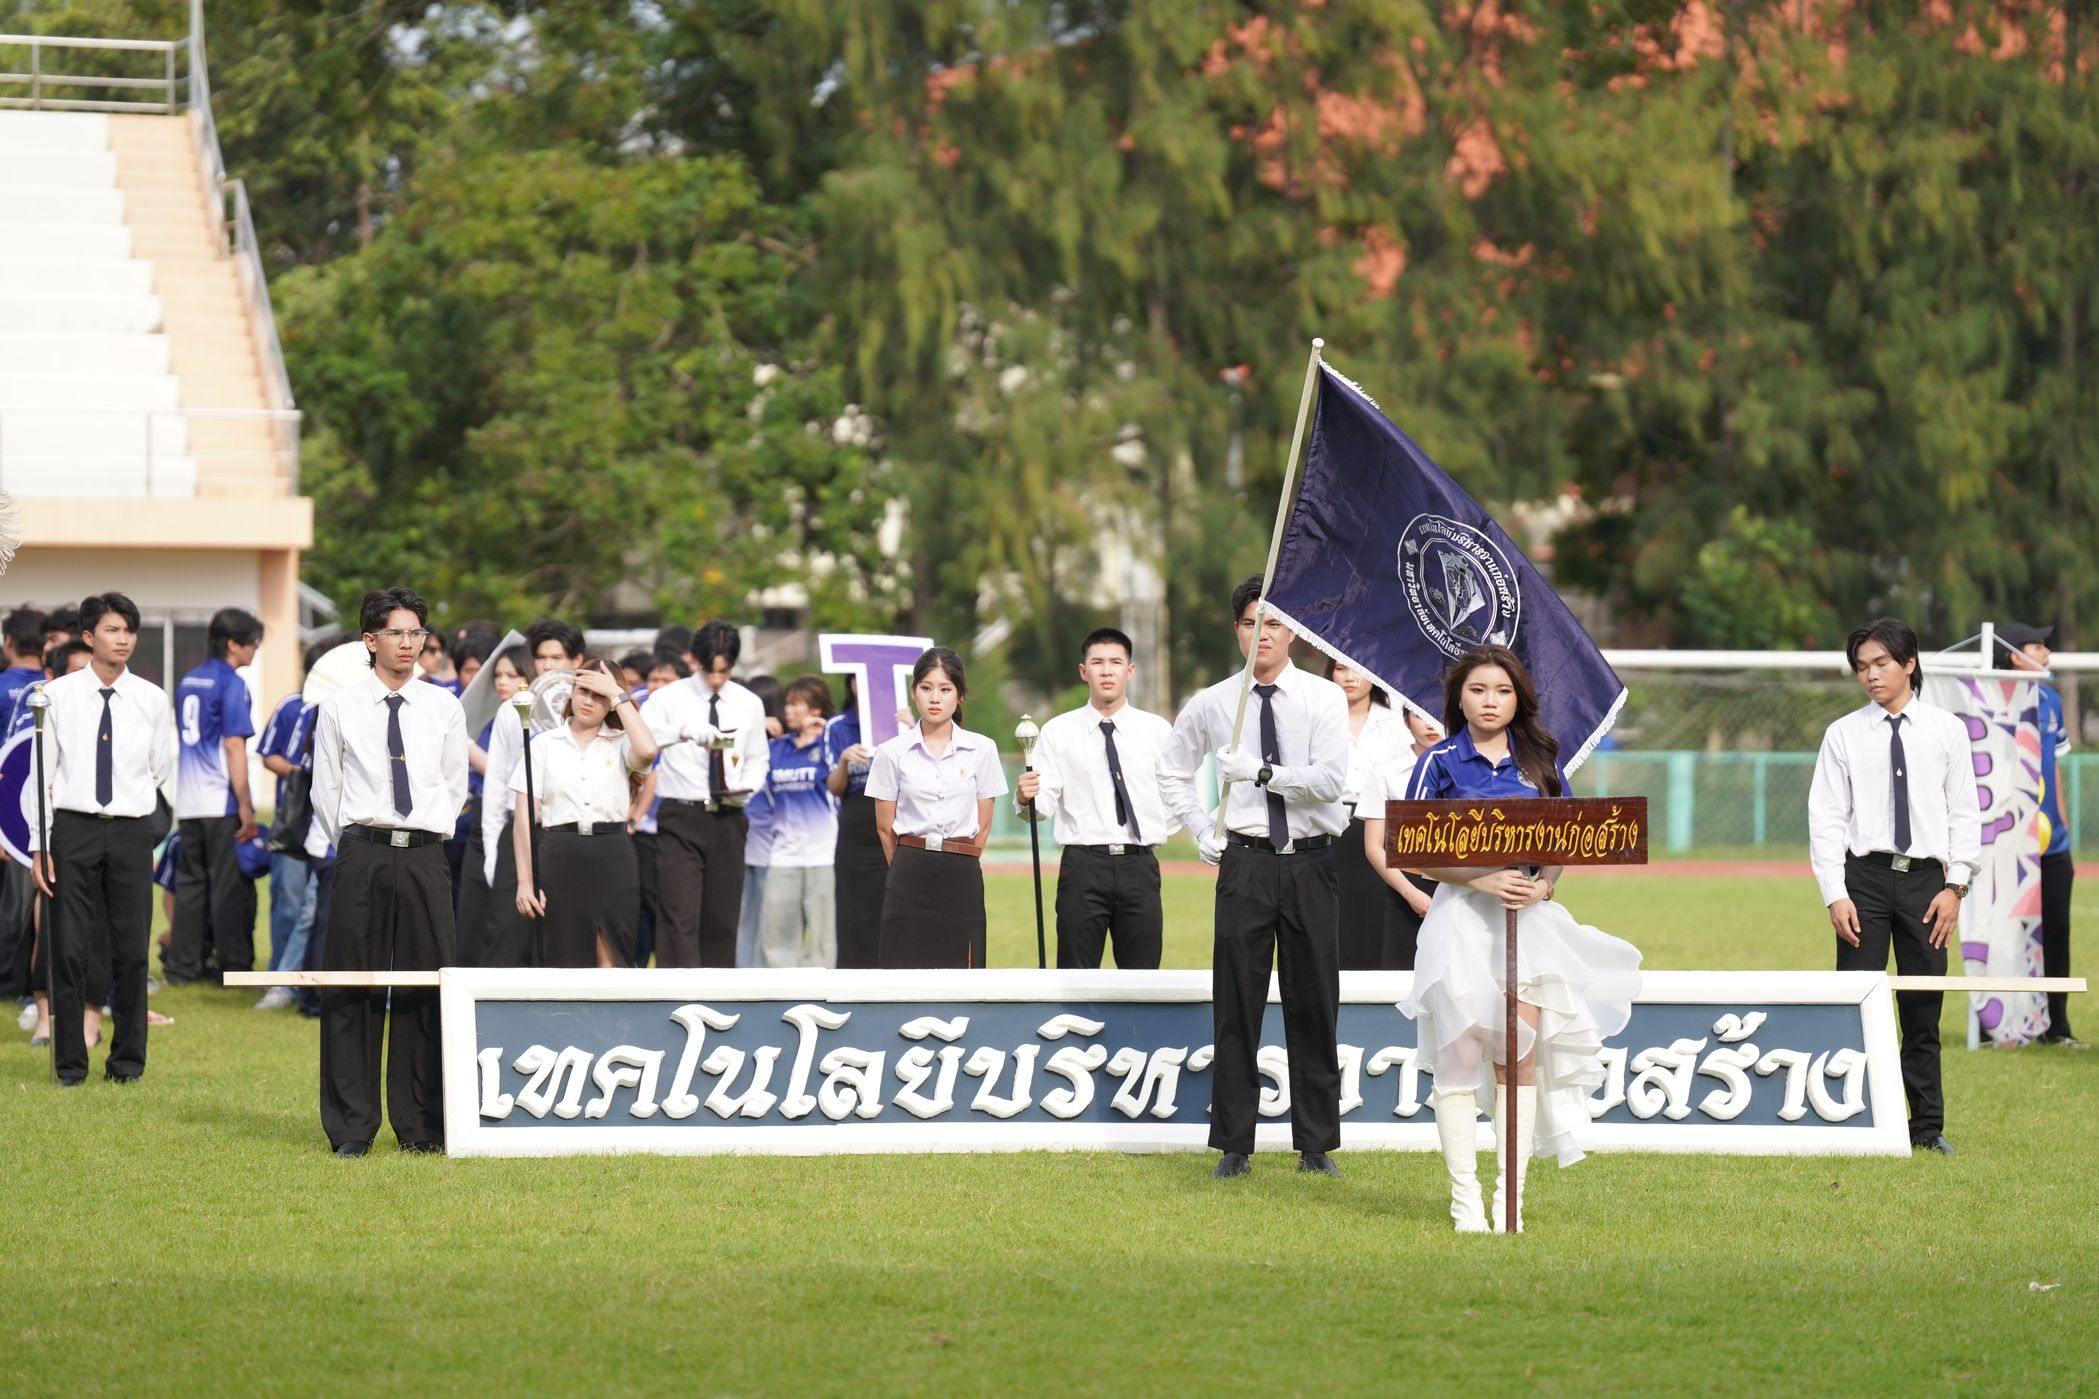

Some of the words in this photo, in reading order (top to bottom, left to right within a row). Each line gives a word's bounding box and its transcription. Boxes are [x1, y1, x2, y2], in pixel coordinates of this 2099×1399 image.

[1404, 561, 1469, 656] มหาวิทยาลัยเทคโนโลยี
[1418, 518, 1516, 618] เทคโนโลยีบริหารงานก่อสร้าง
[182, 694, 201, 747] 9
[819, 634, 934, 758] T
[1397, 805, 1639, 860] เทคโนโลยีบริหารงานก่อสร้าง
